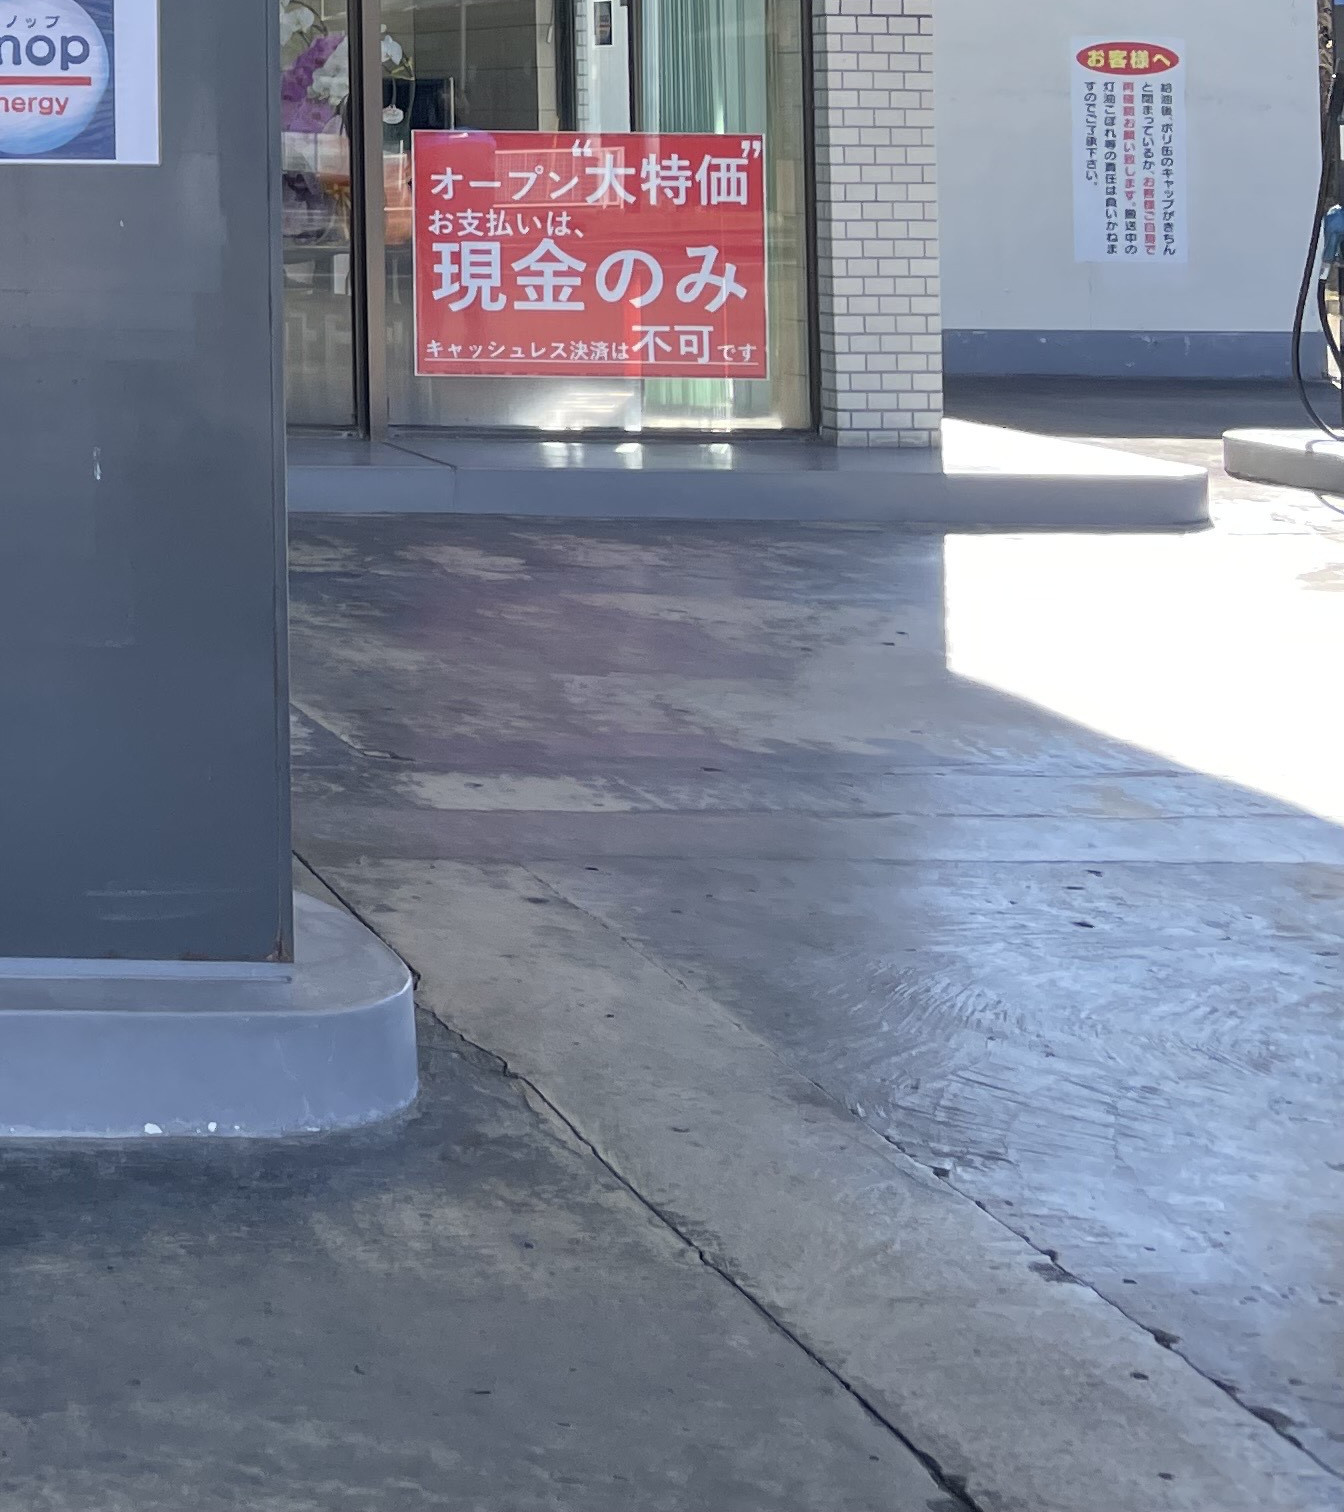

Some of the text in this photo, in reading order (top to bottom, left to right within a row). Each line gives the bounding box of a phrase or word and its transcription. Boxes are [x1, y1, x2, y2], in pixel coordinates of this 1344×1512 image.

[1087, 50, 1171, 69] お客様へ
[428, 209, 584, 238] お支払いは、
[432, 238, 748, 312] 現金のみ
